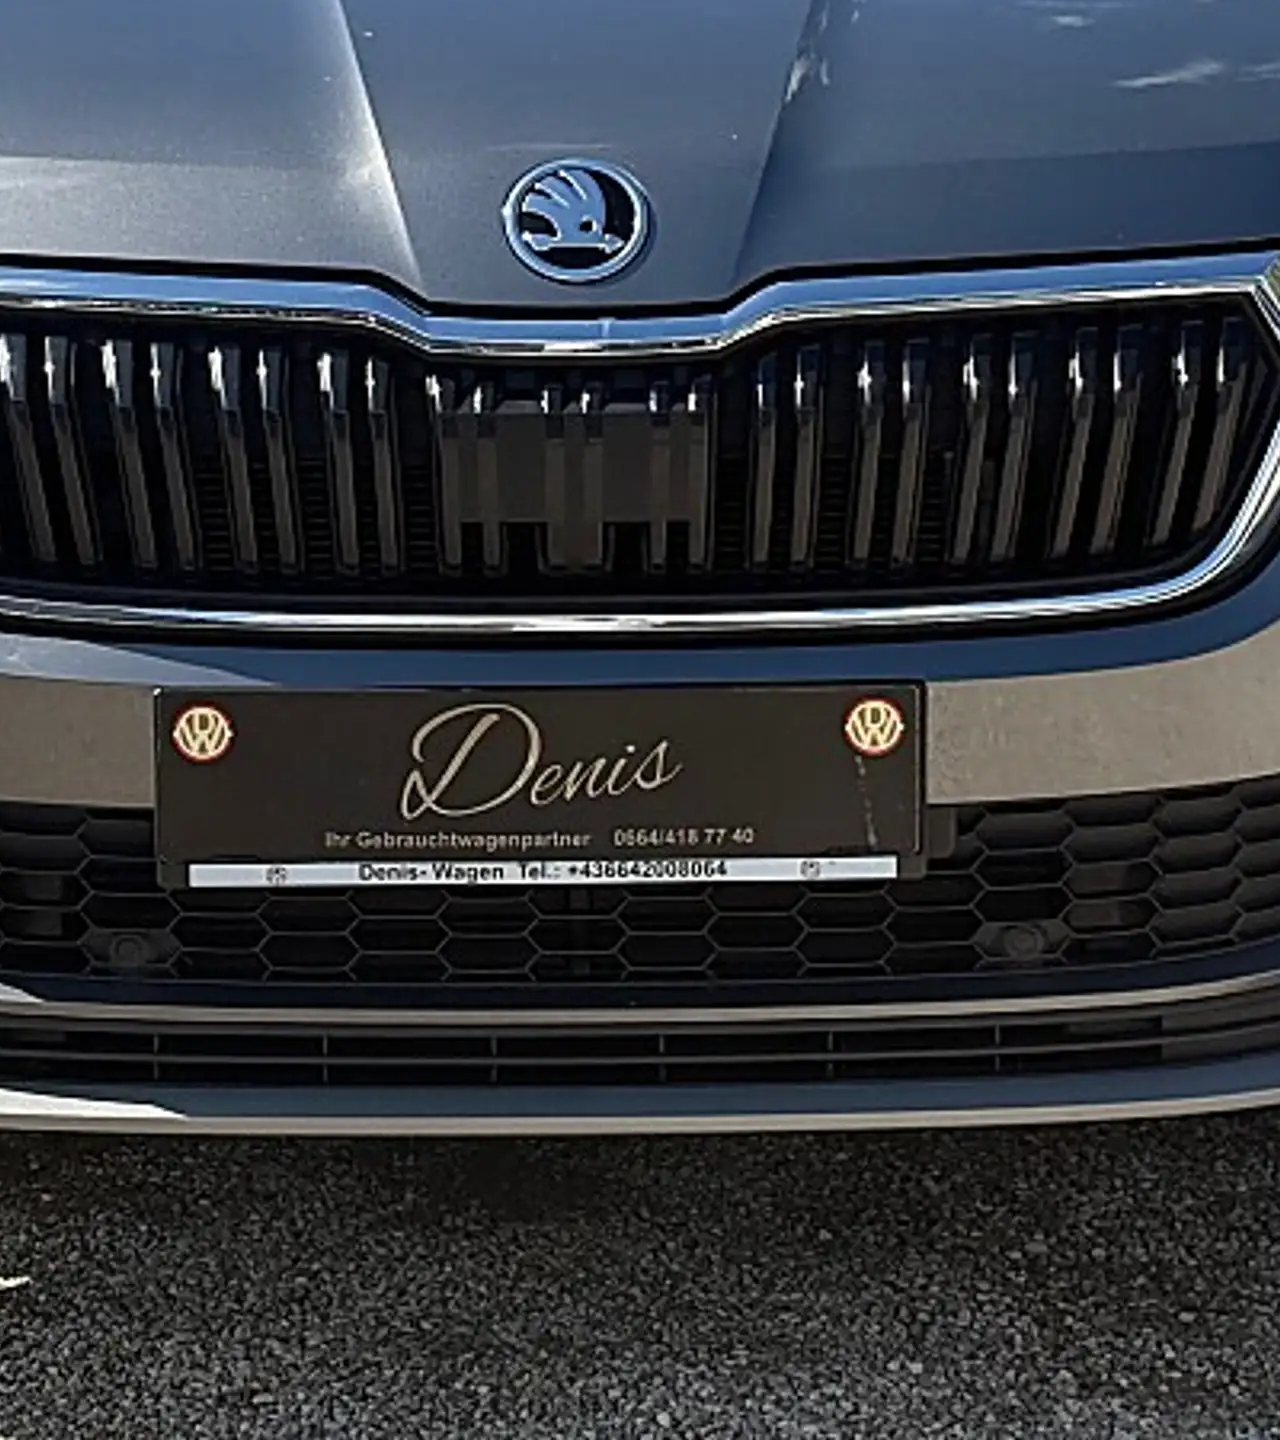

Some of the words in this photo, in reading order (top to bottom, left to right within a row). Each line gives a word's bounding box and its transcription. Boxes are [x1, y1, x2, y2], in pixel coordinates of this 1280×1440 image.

[399, 702, 684, 821] Denis
[324, 831, 352, 849] Ihr
[355, 830, 592, 853] Gebrauchtwagenpartner
[613, 827, 700, 847] 0664/418
[703, 827, 725, 845] 77
[732, 826, 755, 844] 40
[431, 861, 505, 885] Wagen
